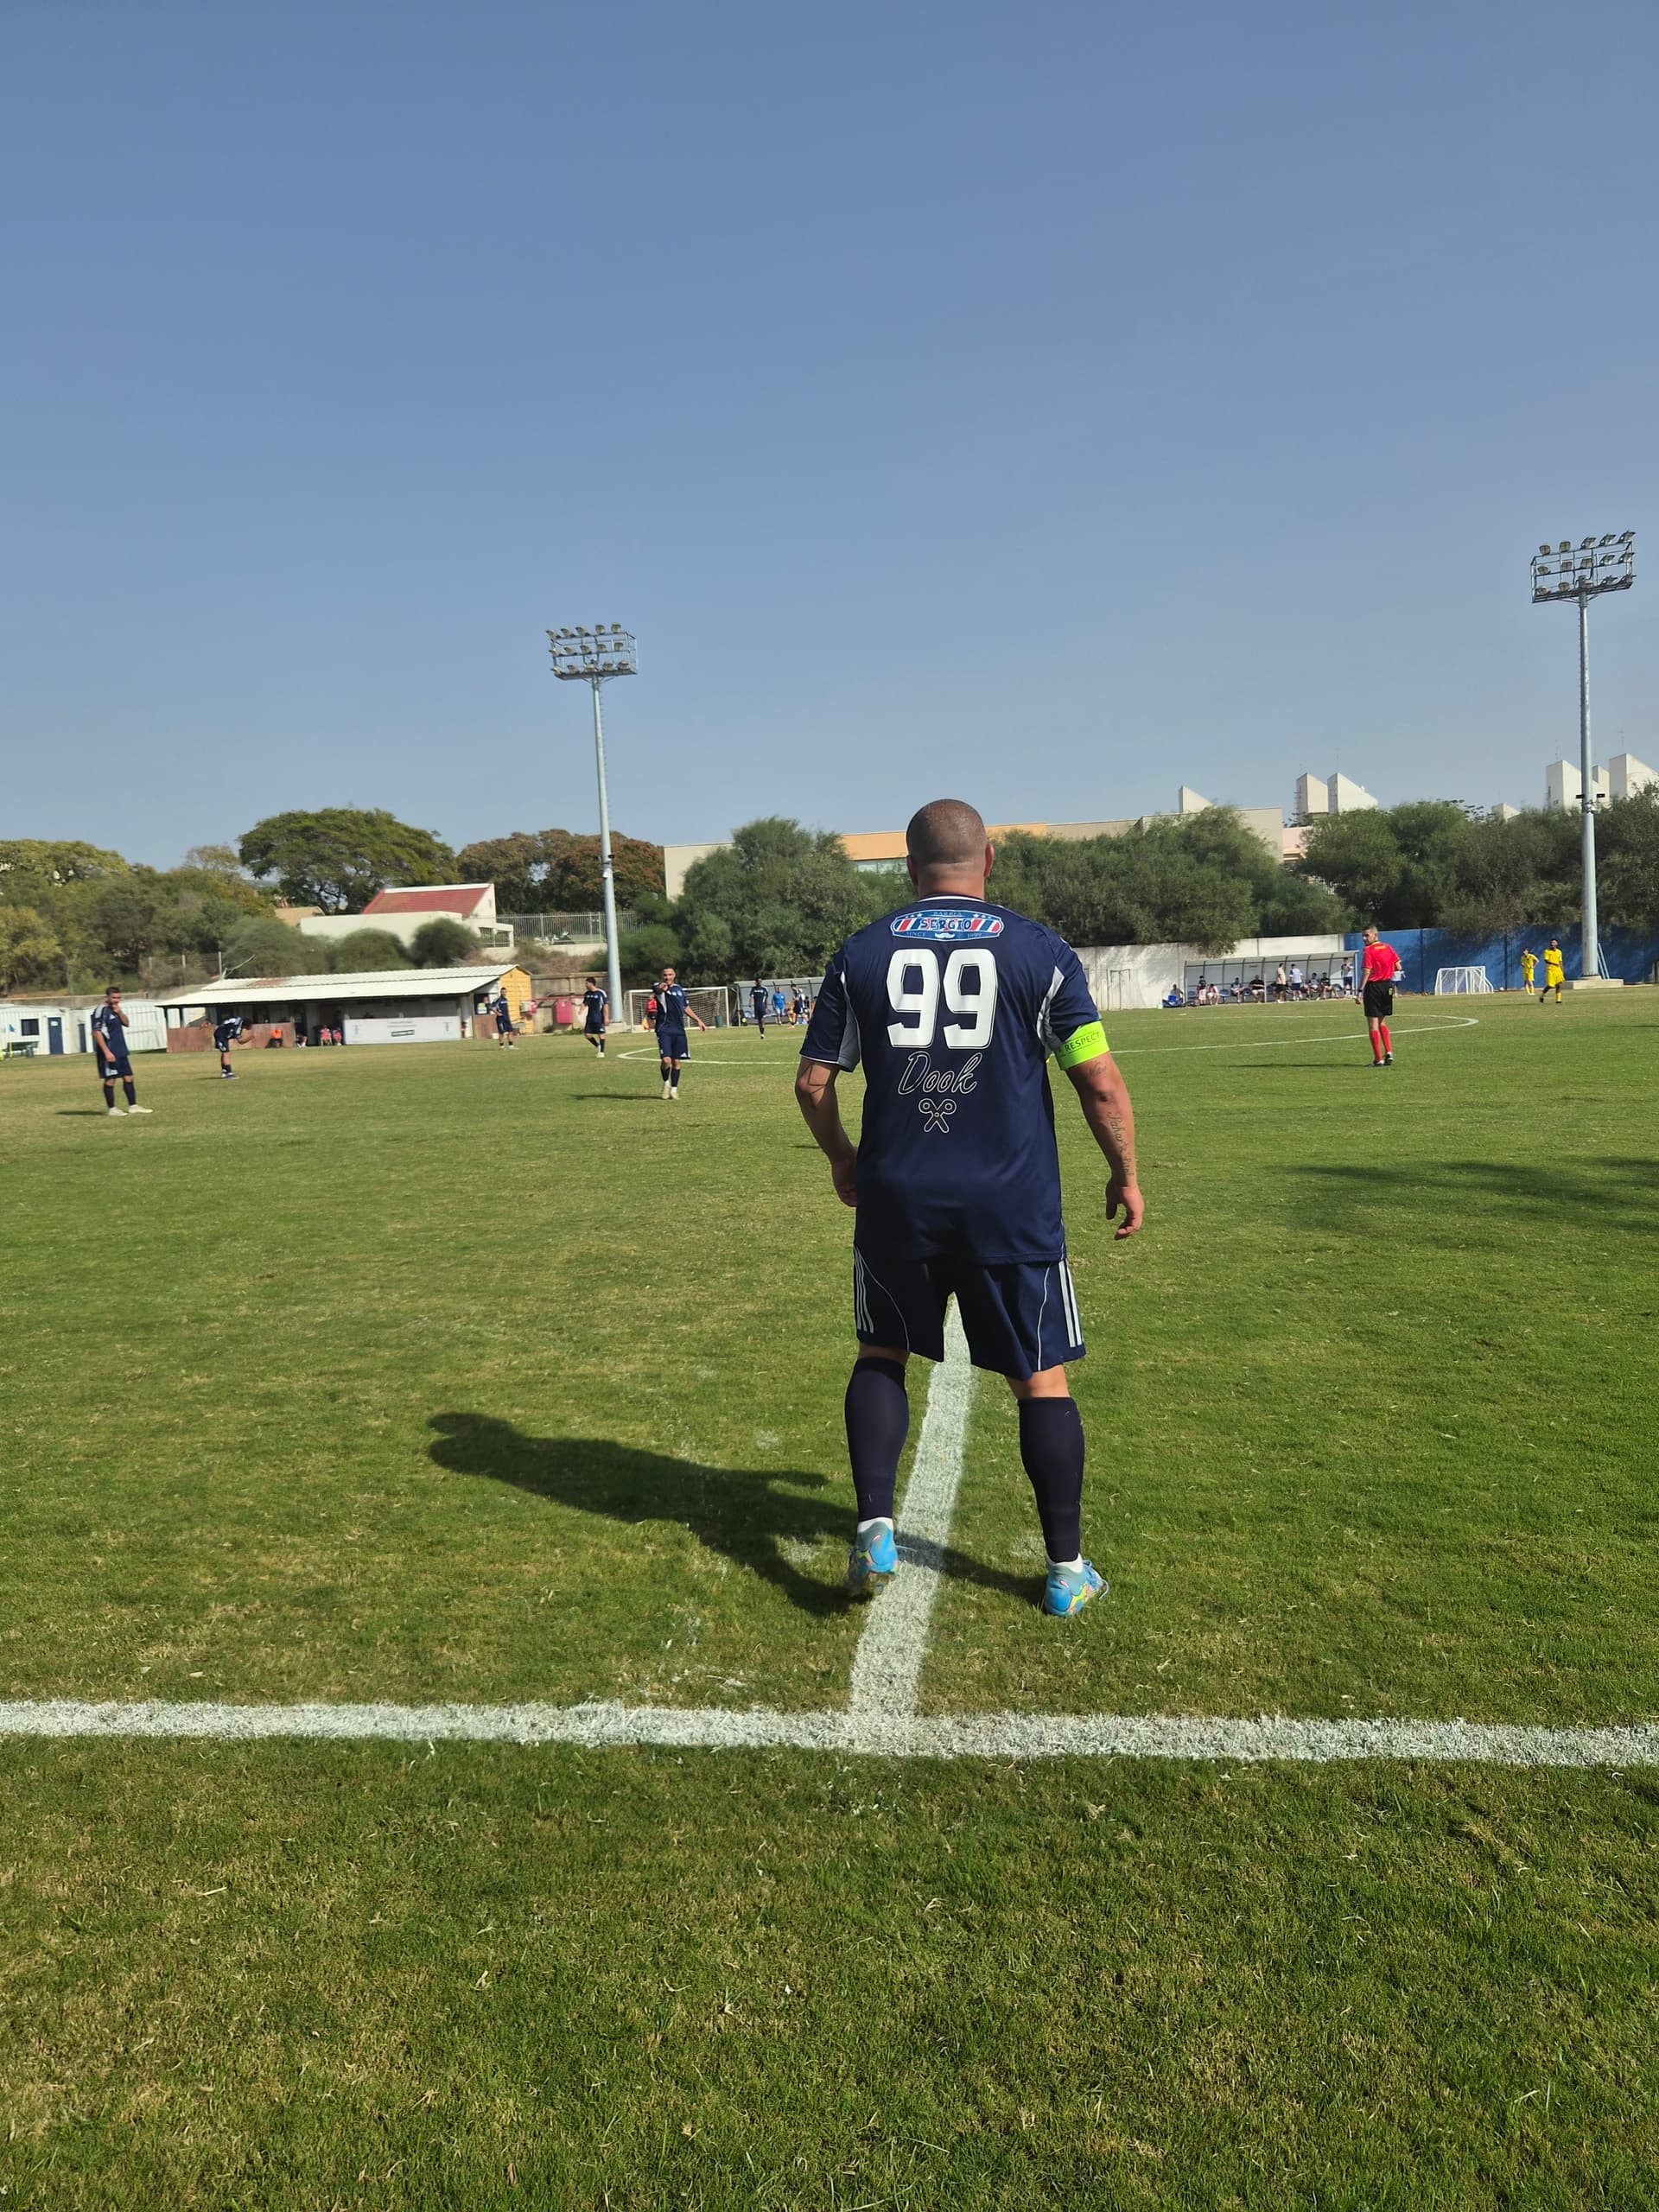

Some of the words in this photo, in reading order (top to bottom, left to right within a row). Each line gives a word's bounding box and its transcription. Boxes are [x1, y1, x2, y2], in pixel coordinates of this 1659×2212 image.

[920, 918, 971, 931] SERGIO
[887, 949, 998, 1049] 99
[1065, 1031, 1100, 1052] RESPECT
[898, 1051, 982, 1095] Dook
